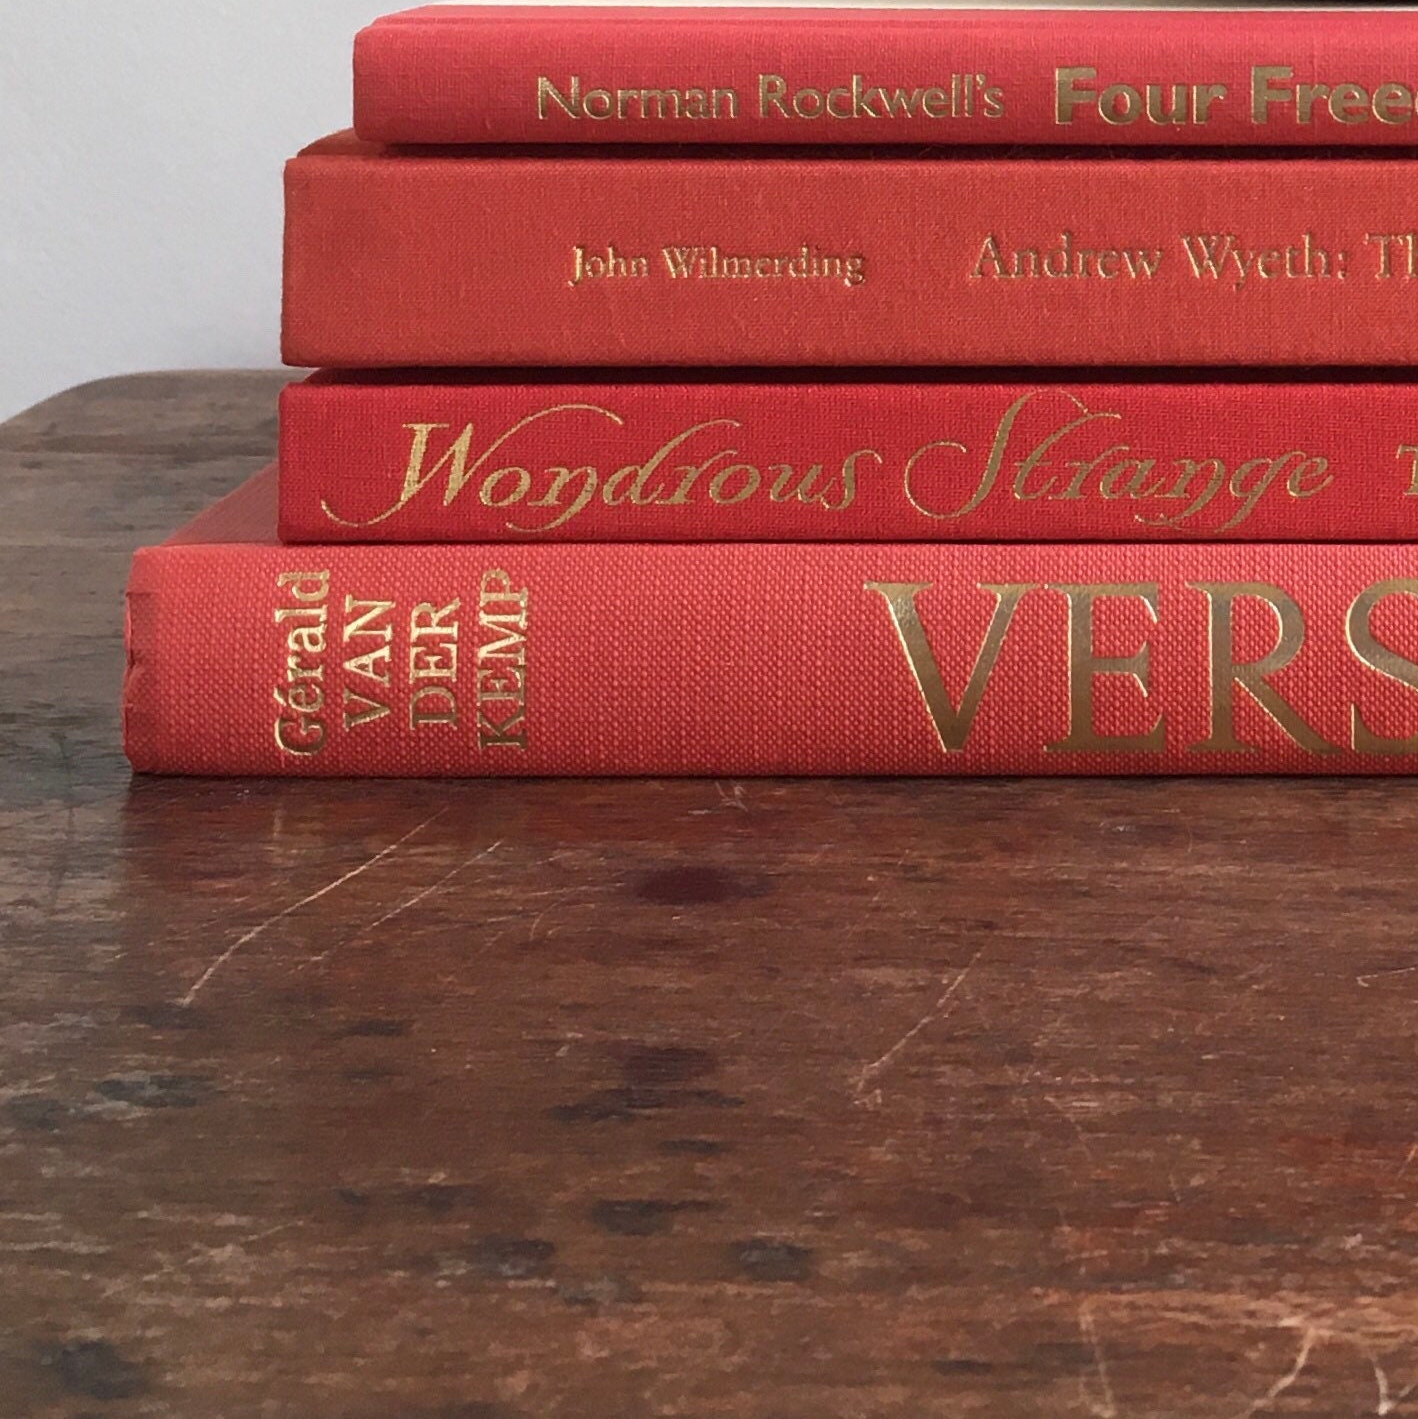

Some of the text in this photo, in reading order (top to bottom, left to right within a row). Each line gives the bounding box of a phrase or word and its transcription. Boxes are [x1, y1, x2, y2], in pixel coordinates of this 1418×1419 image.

[537, 75, 738, 120] Norman
[1054, 66, 1226, 126] Four
[567, 244, 866, 287] John Wilmerding
[968, 233, 1164, 280] Andrew
[1181, 232, 1349, 291] Wyeth:
[320, 388, 1335, 534] Wondrous Strange
[274, 568, 330, 756] Gérald
[343, 593, 396, 732] VAN
[409, 597, 461, 731] DER
[477, 567, 529, 751] KEMP
